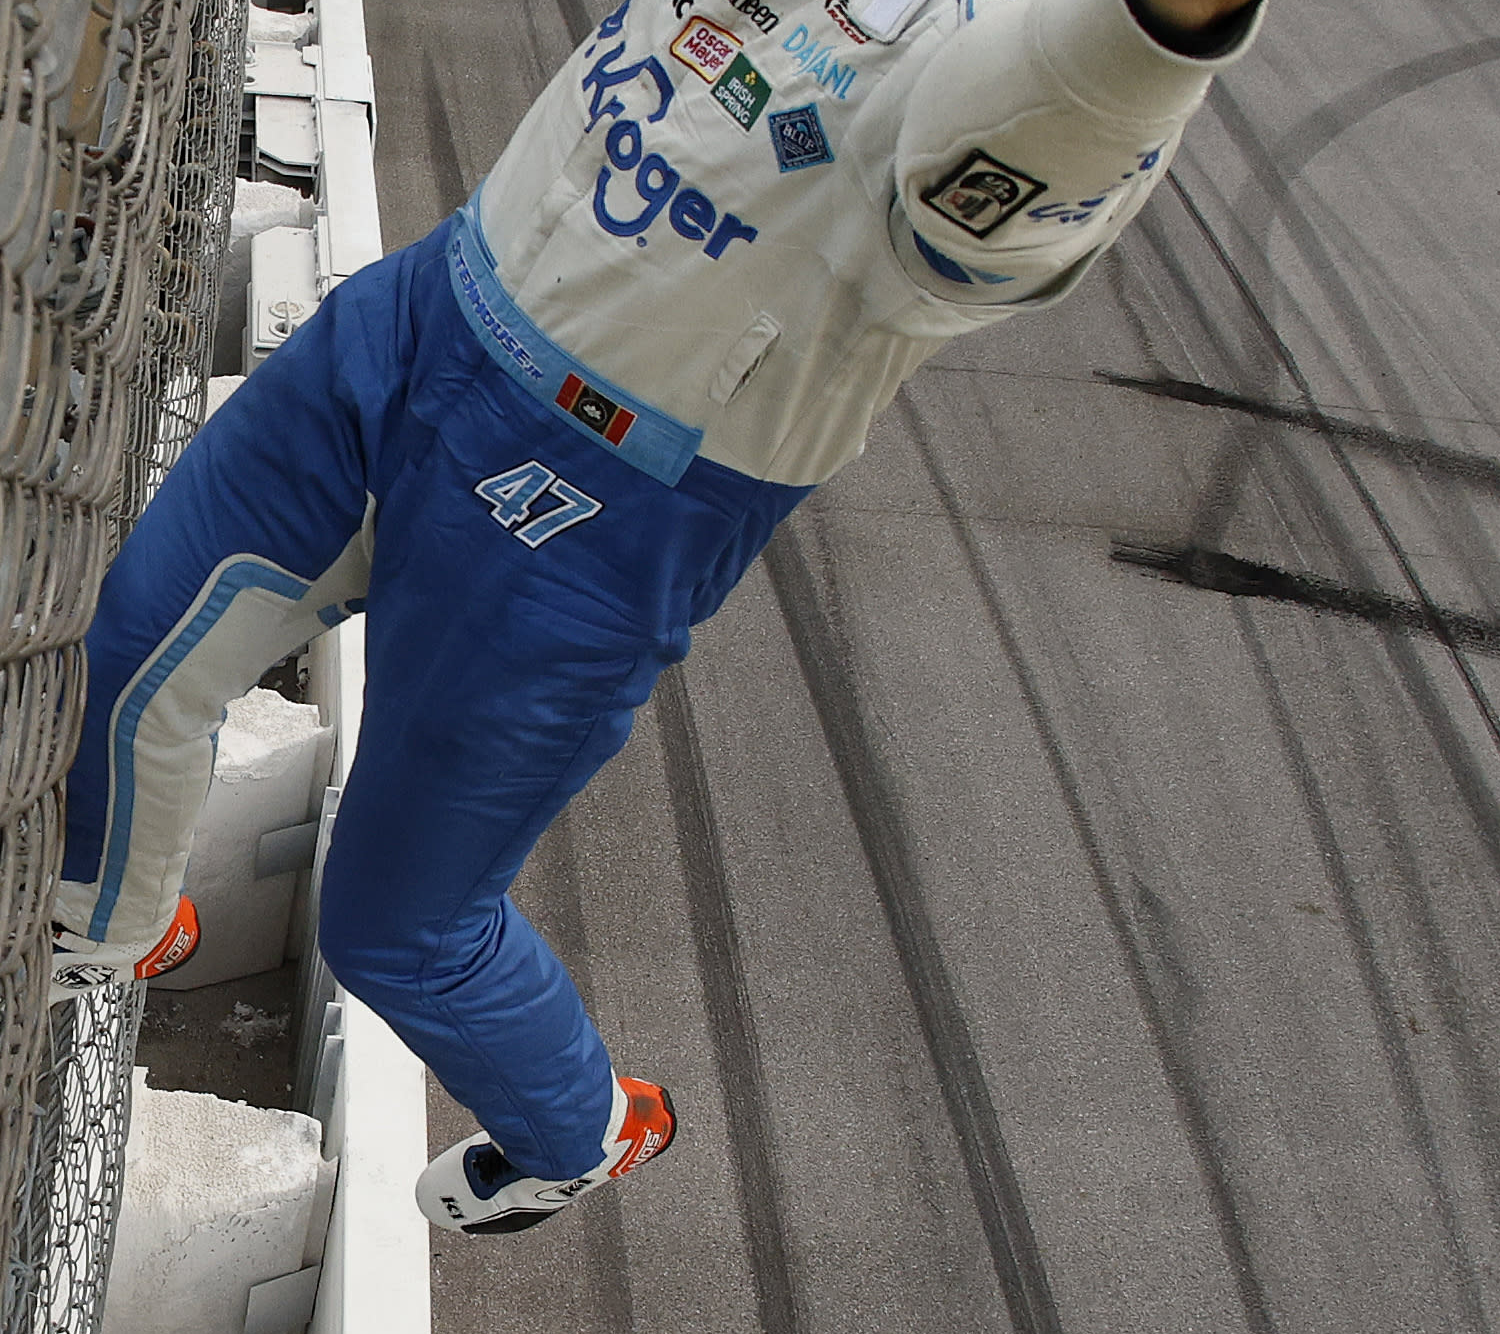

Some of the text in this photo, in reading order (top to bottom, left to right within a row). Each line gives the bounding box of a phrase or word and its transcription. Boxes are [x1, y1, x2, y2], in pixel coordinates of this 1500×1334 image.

[683, 36, 724, 70] Mayer
[695, 27, 734, 57] Oscar
[714, 85, 752, 125] SPRING
[727, 75, 756, 107] IRISH
[582, 41, 758, 261] Kroger
[451, 235, 531, 369] STENHOUSE
[474, 457, 604, 551] 47
